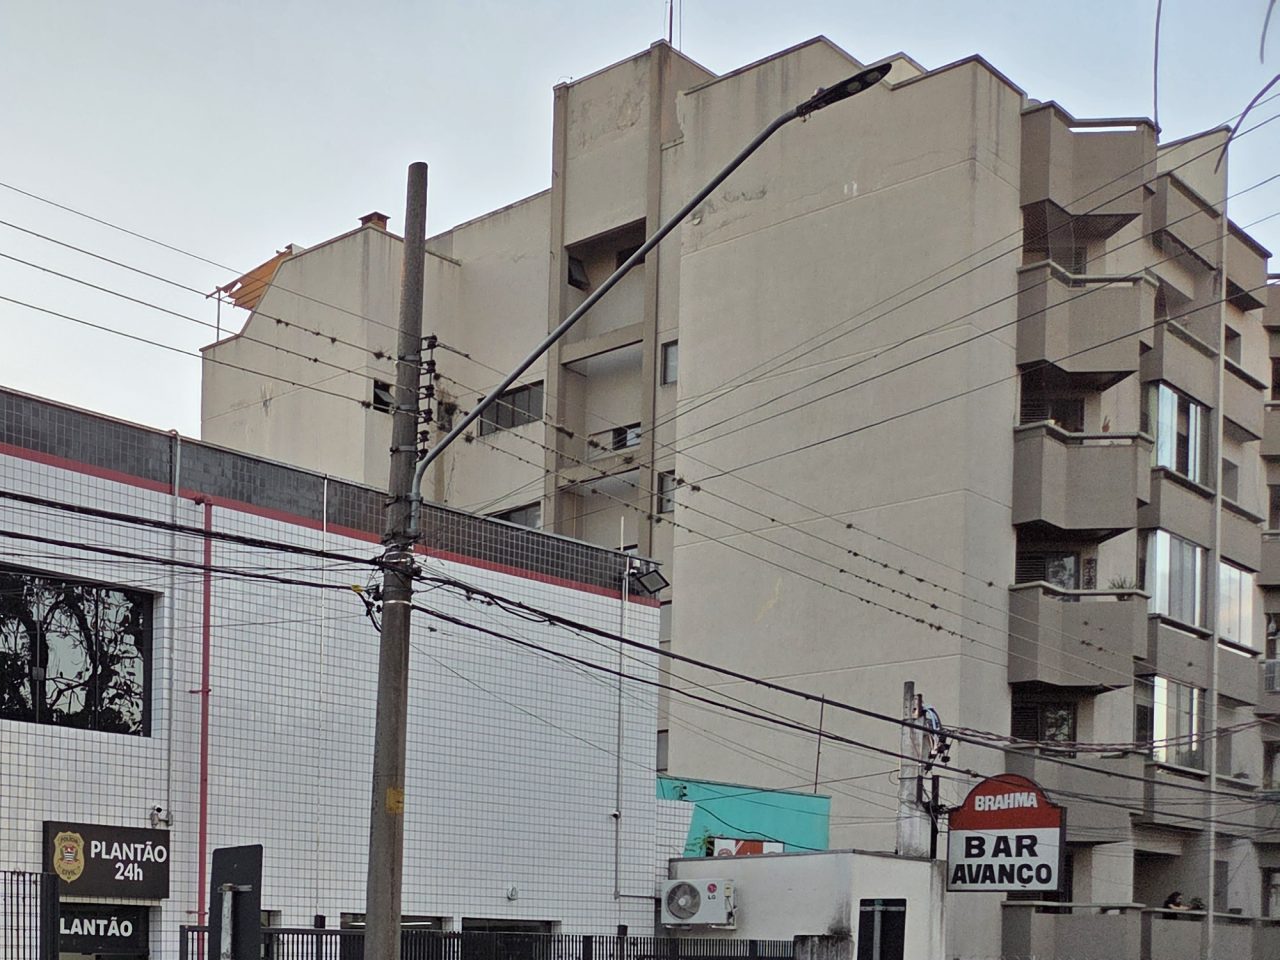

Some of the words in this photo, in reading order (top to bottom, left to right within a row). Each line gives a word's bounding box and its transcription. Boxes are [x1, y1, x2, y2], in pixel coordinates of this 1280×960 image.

[974, 792, 1038, 811] BRAHMA
[90, 841, 167, 863] PLANTÃO
[965, 835, 1038, 858] BAR
[115, 863, 143, 881] 24h
[951, 864, 1052, 888] AVANÇO
[60, 917, 133, 937] LANTÃO
